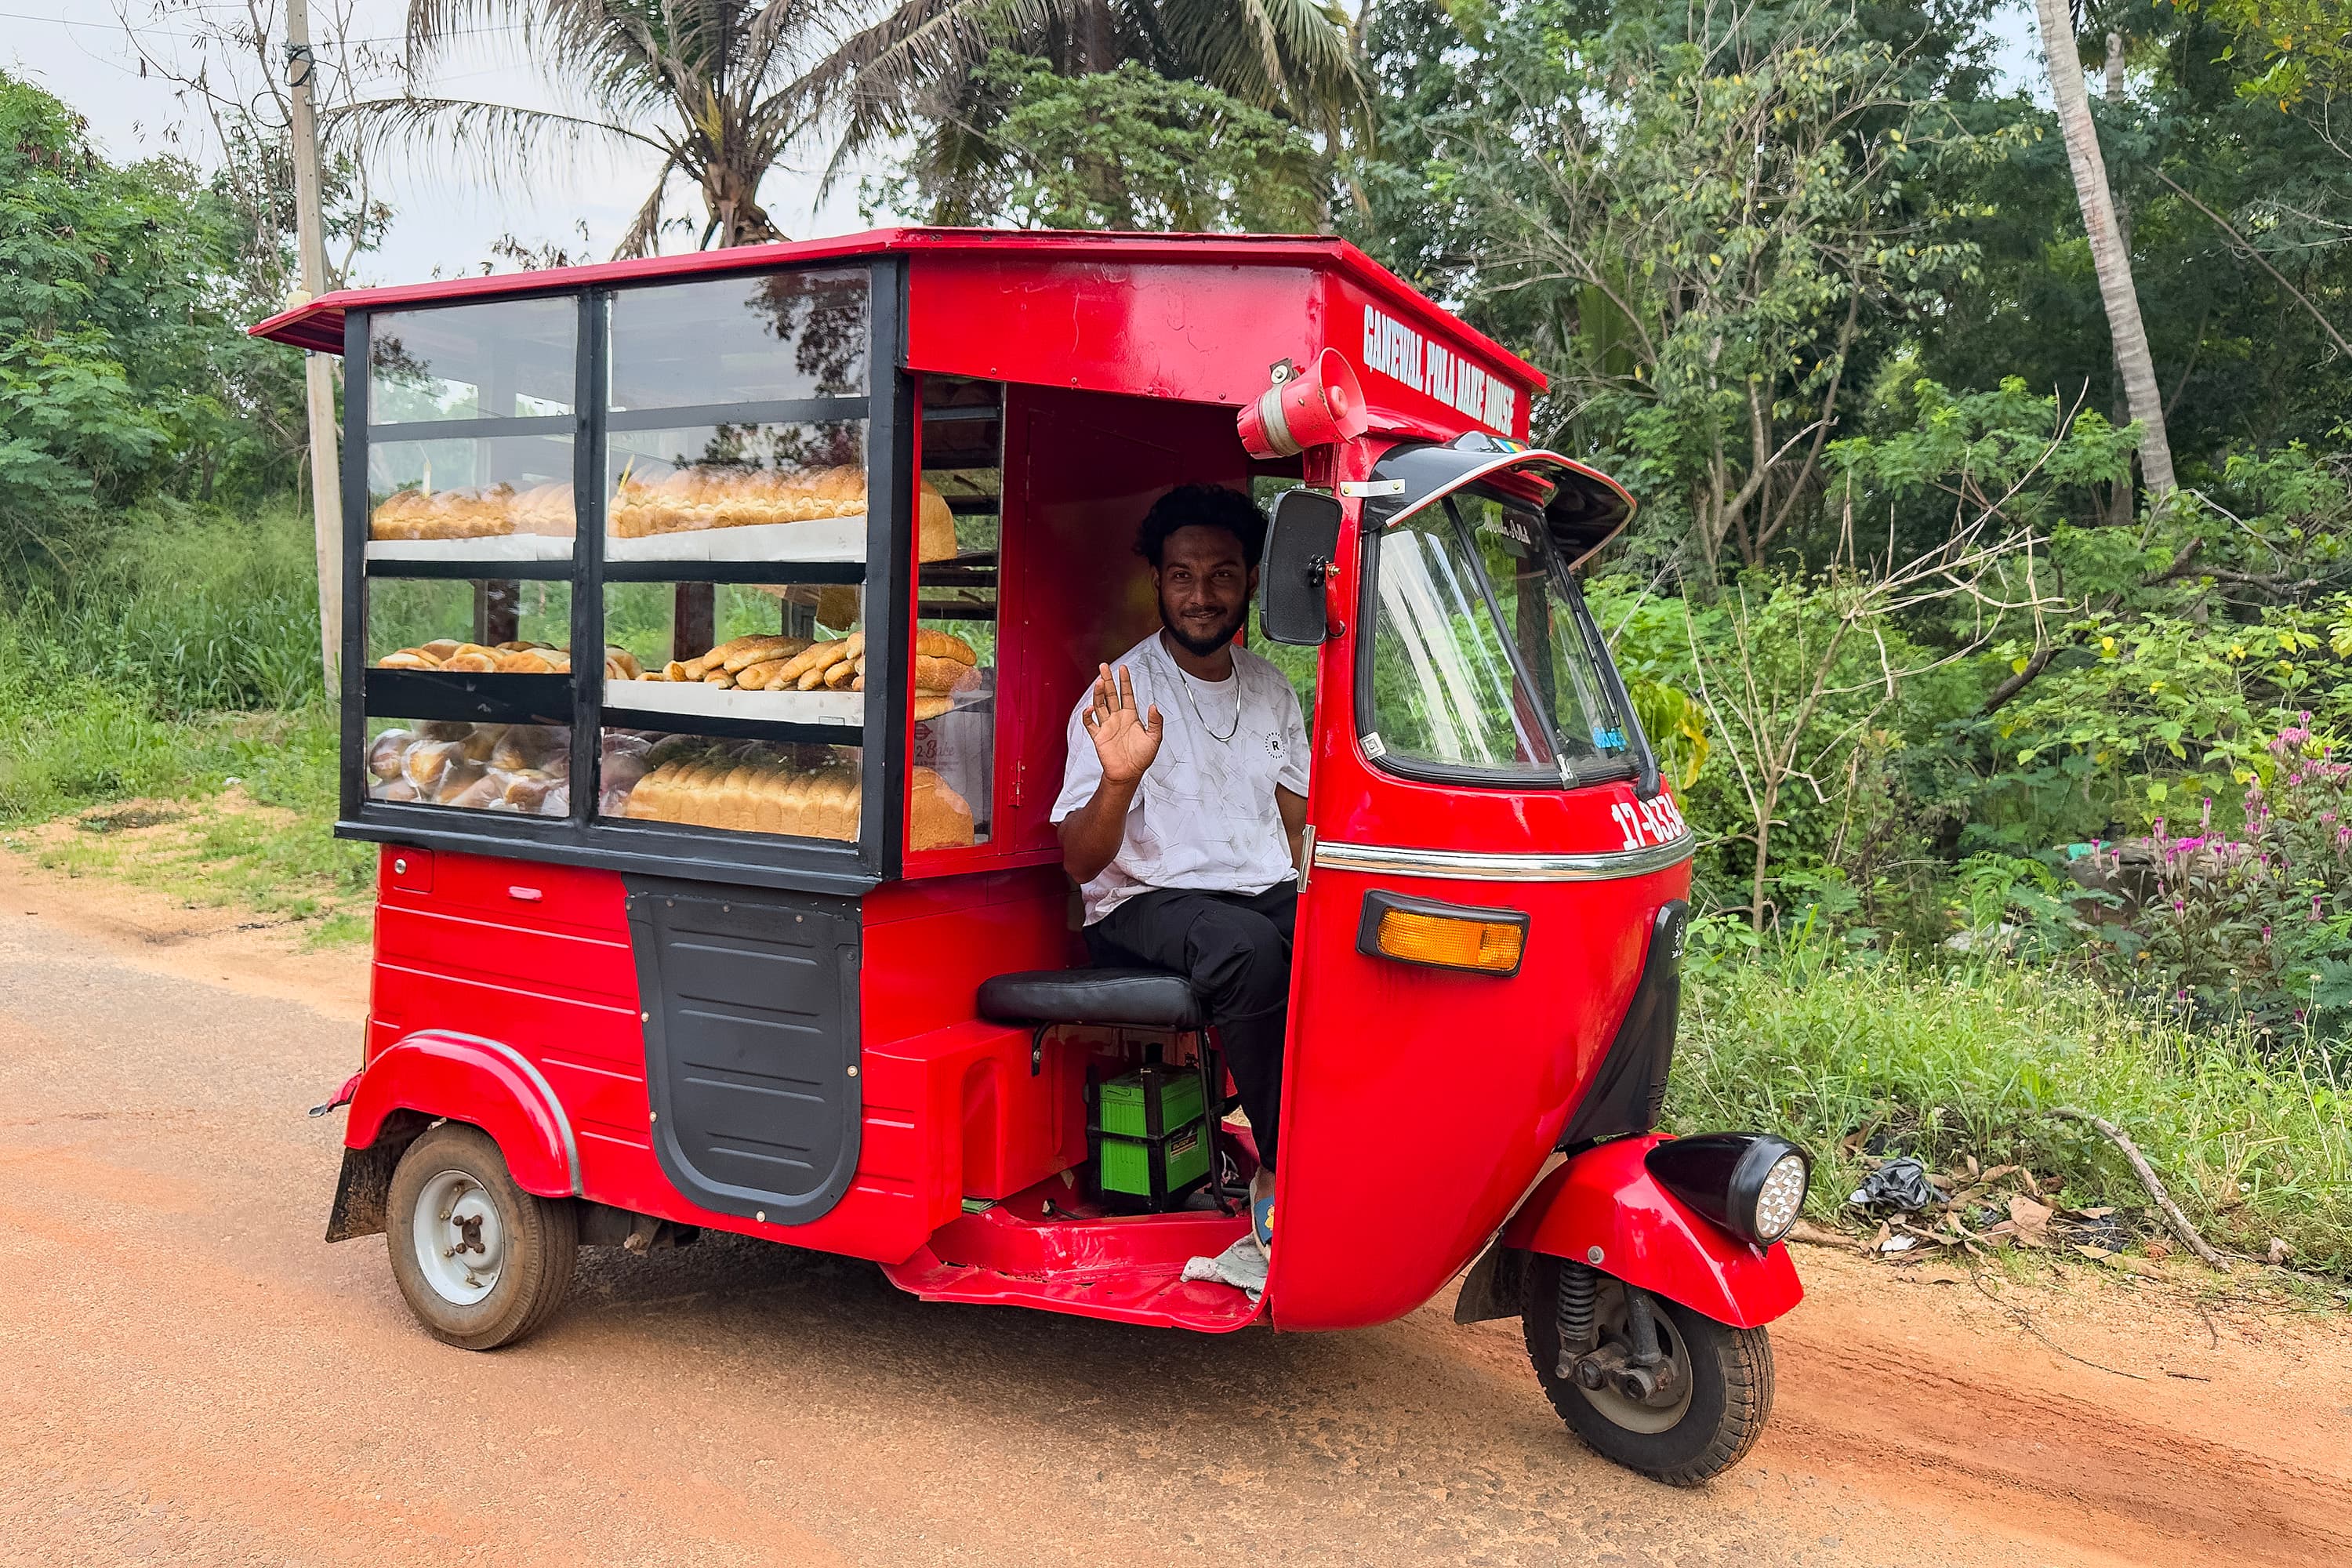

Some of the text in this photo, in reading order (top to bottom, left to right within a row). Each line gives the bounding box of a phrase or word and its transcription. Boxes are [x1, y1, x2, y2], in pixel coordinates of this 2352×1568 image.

[1425, 339, 1454, 408] POLA
[1483, 374, 1515, 437] HOUSE
[1272, 740, 1279, 750] R
[1611, 793, 1685, 851] 17-8334
